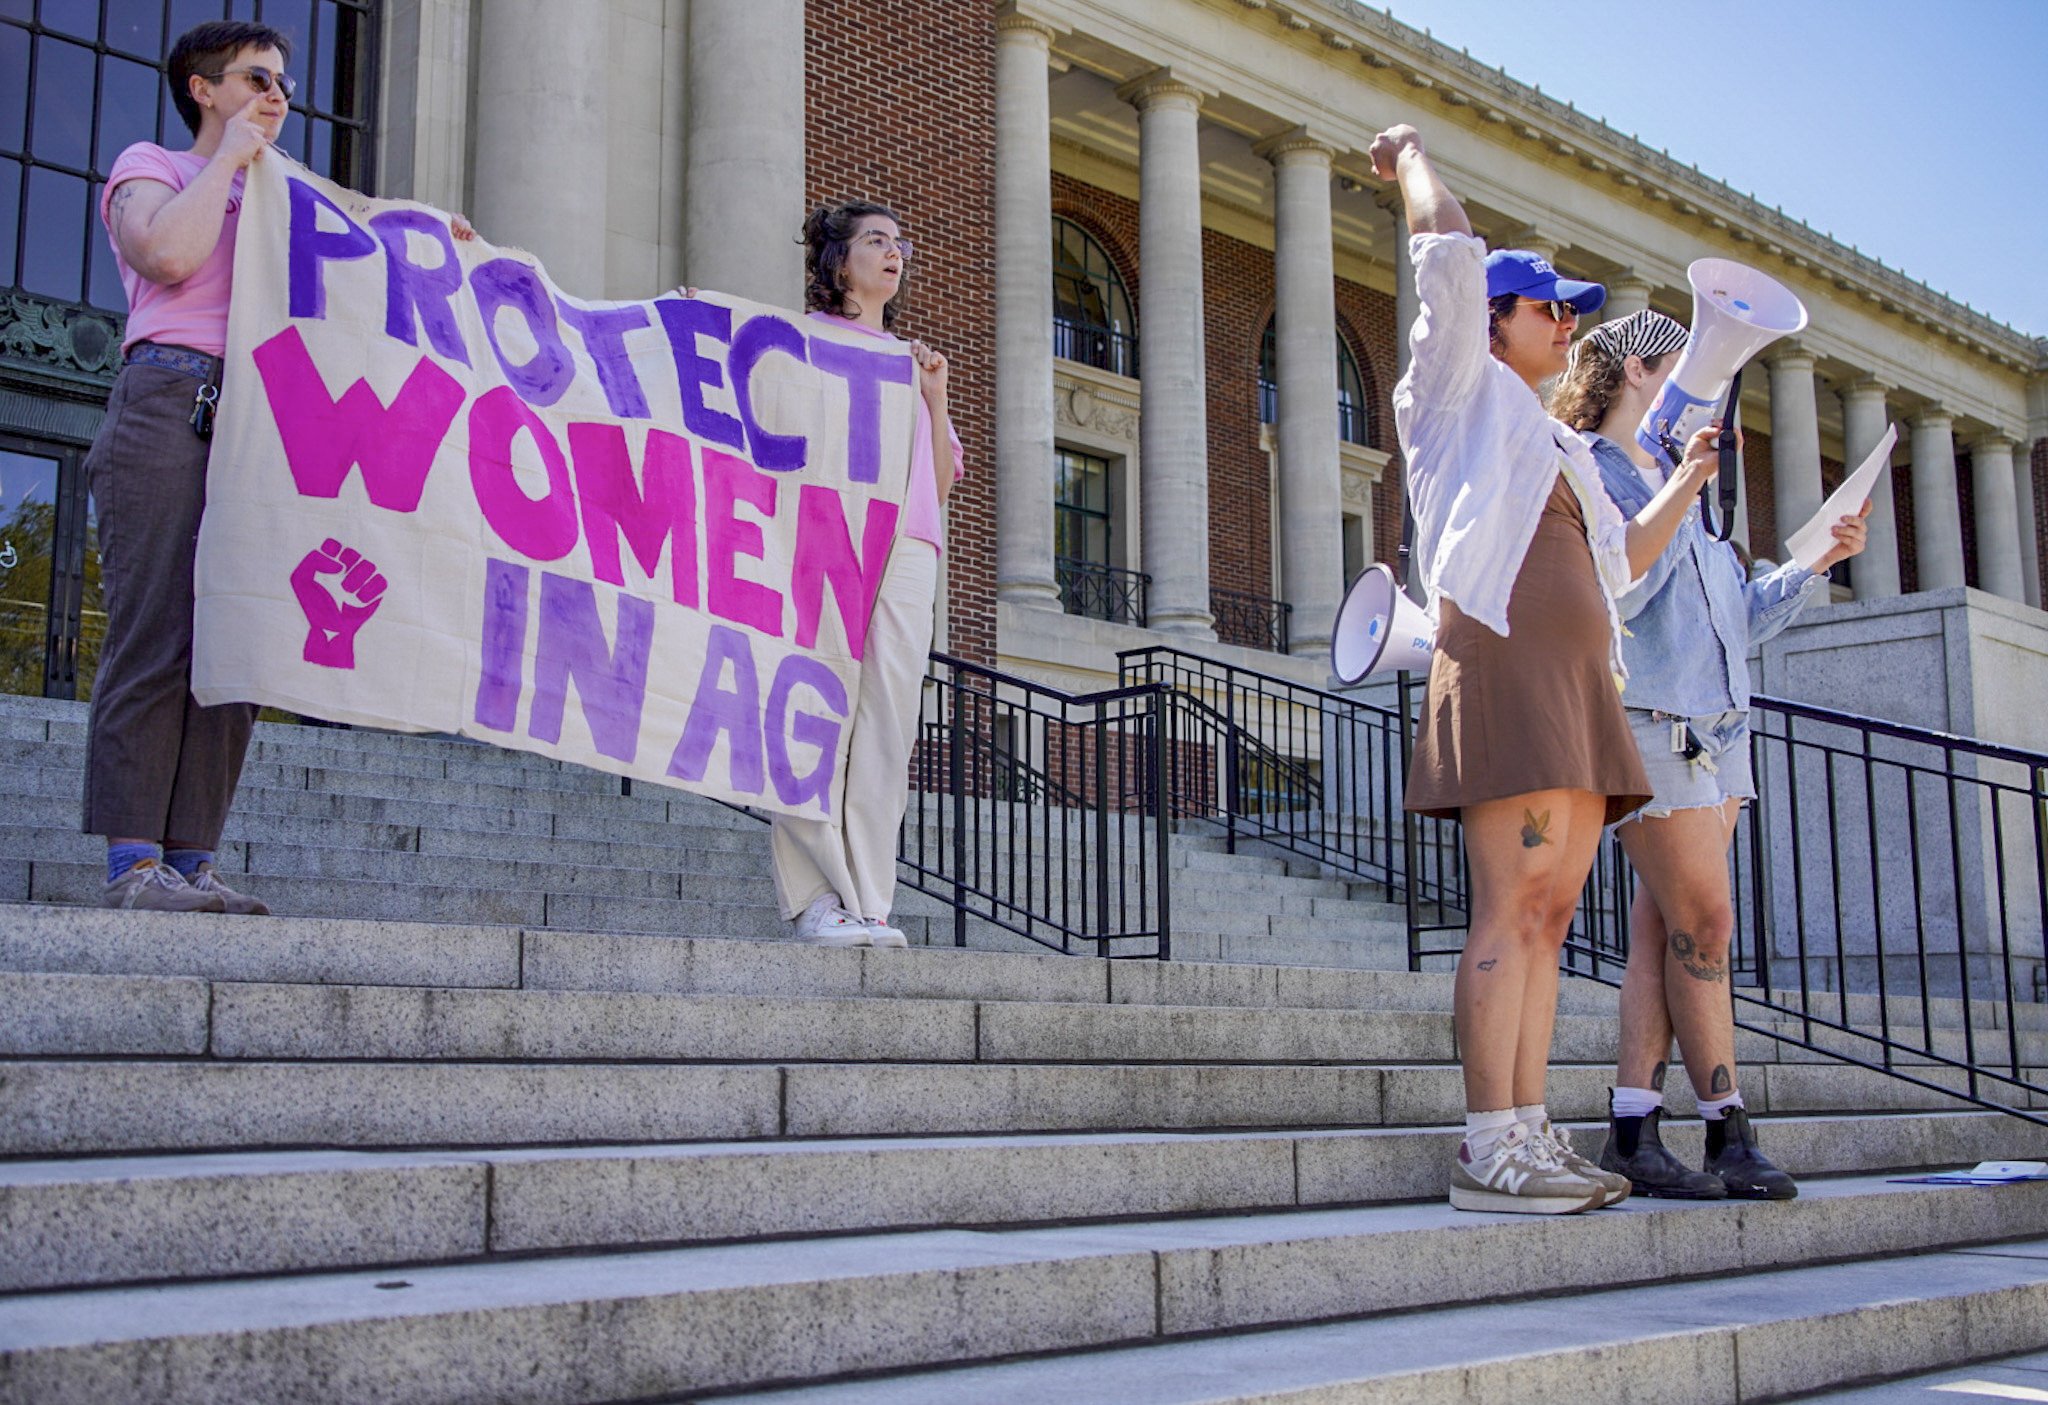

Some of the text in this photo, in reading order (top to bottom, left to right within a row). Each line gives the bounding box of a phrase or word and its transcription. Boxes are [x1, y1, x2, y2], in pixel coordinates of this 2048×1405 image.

[286, 175, 913, 485] PROTECT
[251, 324, 900, 663] WOMEN
[474, 557, 850, 814] IN AG
